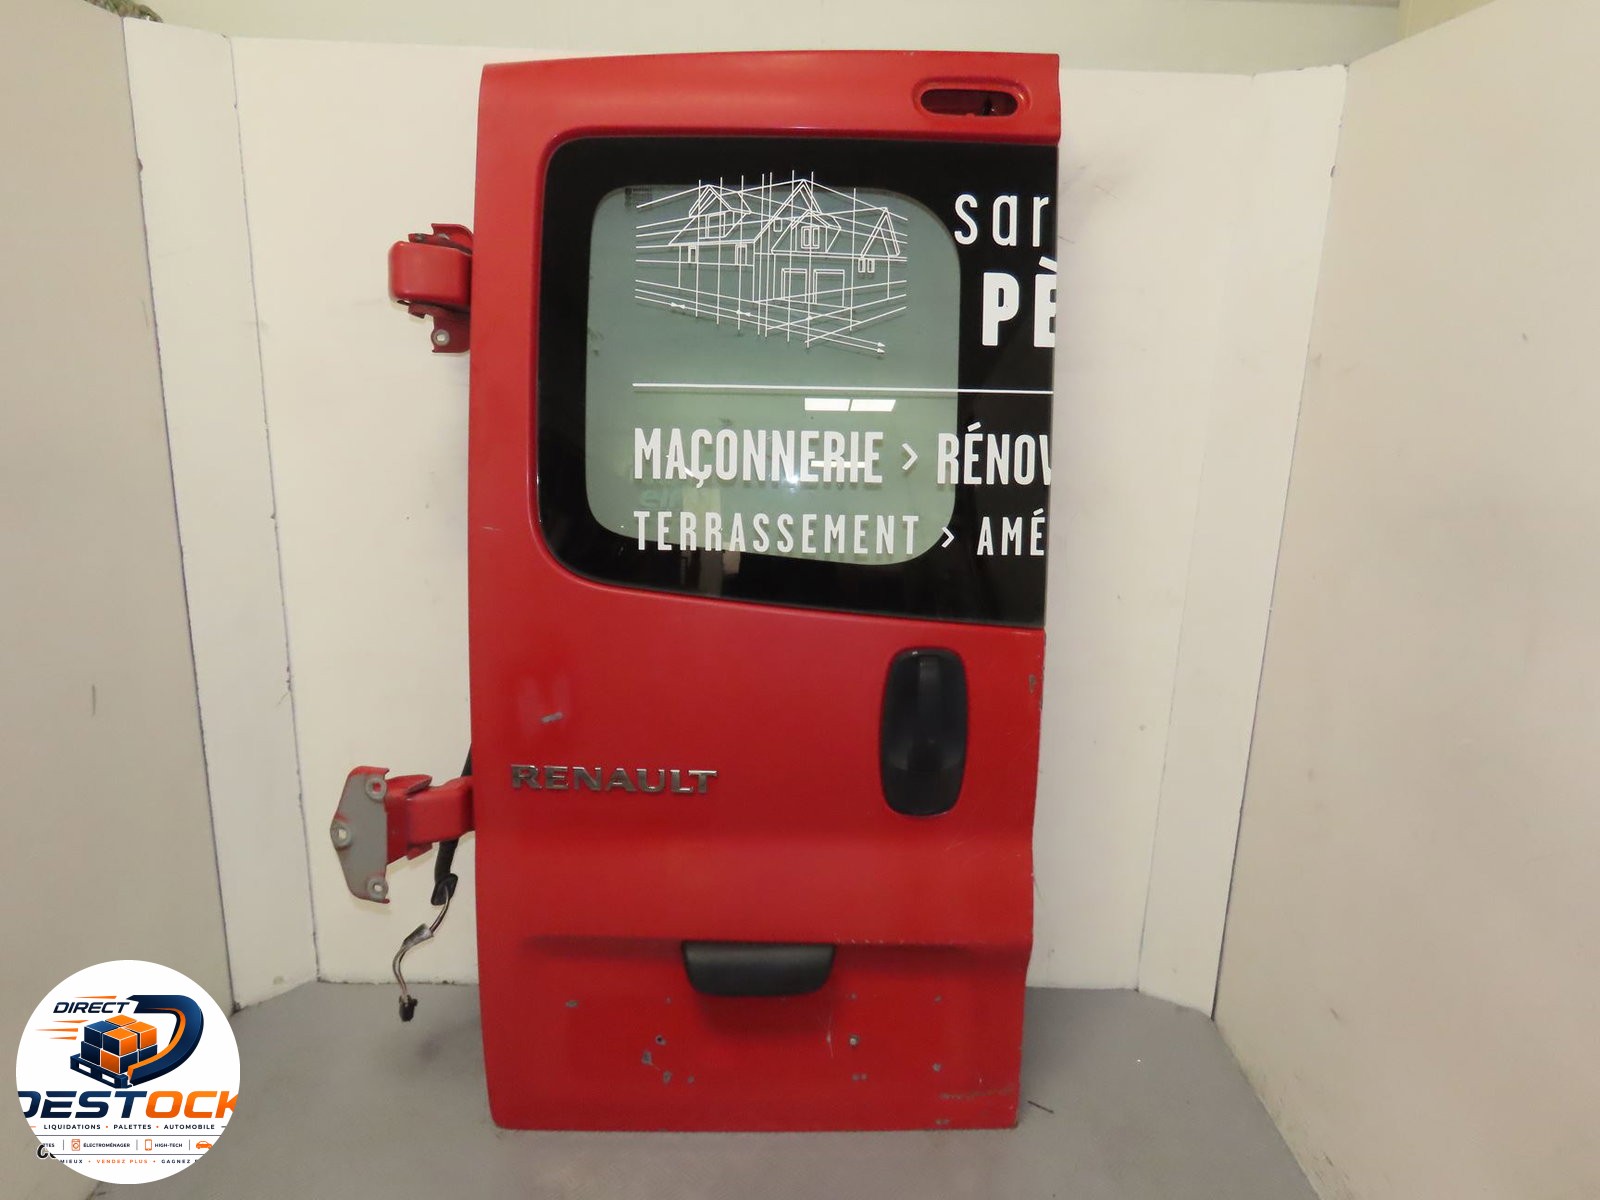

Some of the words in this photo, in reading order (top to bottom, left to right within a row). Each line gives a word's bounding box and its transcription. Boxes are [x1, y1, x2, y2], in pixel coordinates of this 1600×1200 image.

[954, 194, 1049, 247] sar
[633, 427, 884, 488] MAÇONNERIE
[633, 511, 919, 555] TERRASSEMENT
[976, 507, 1046, 556] AMÉ
[510, 763, 718, 794] RENAULT
